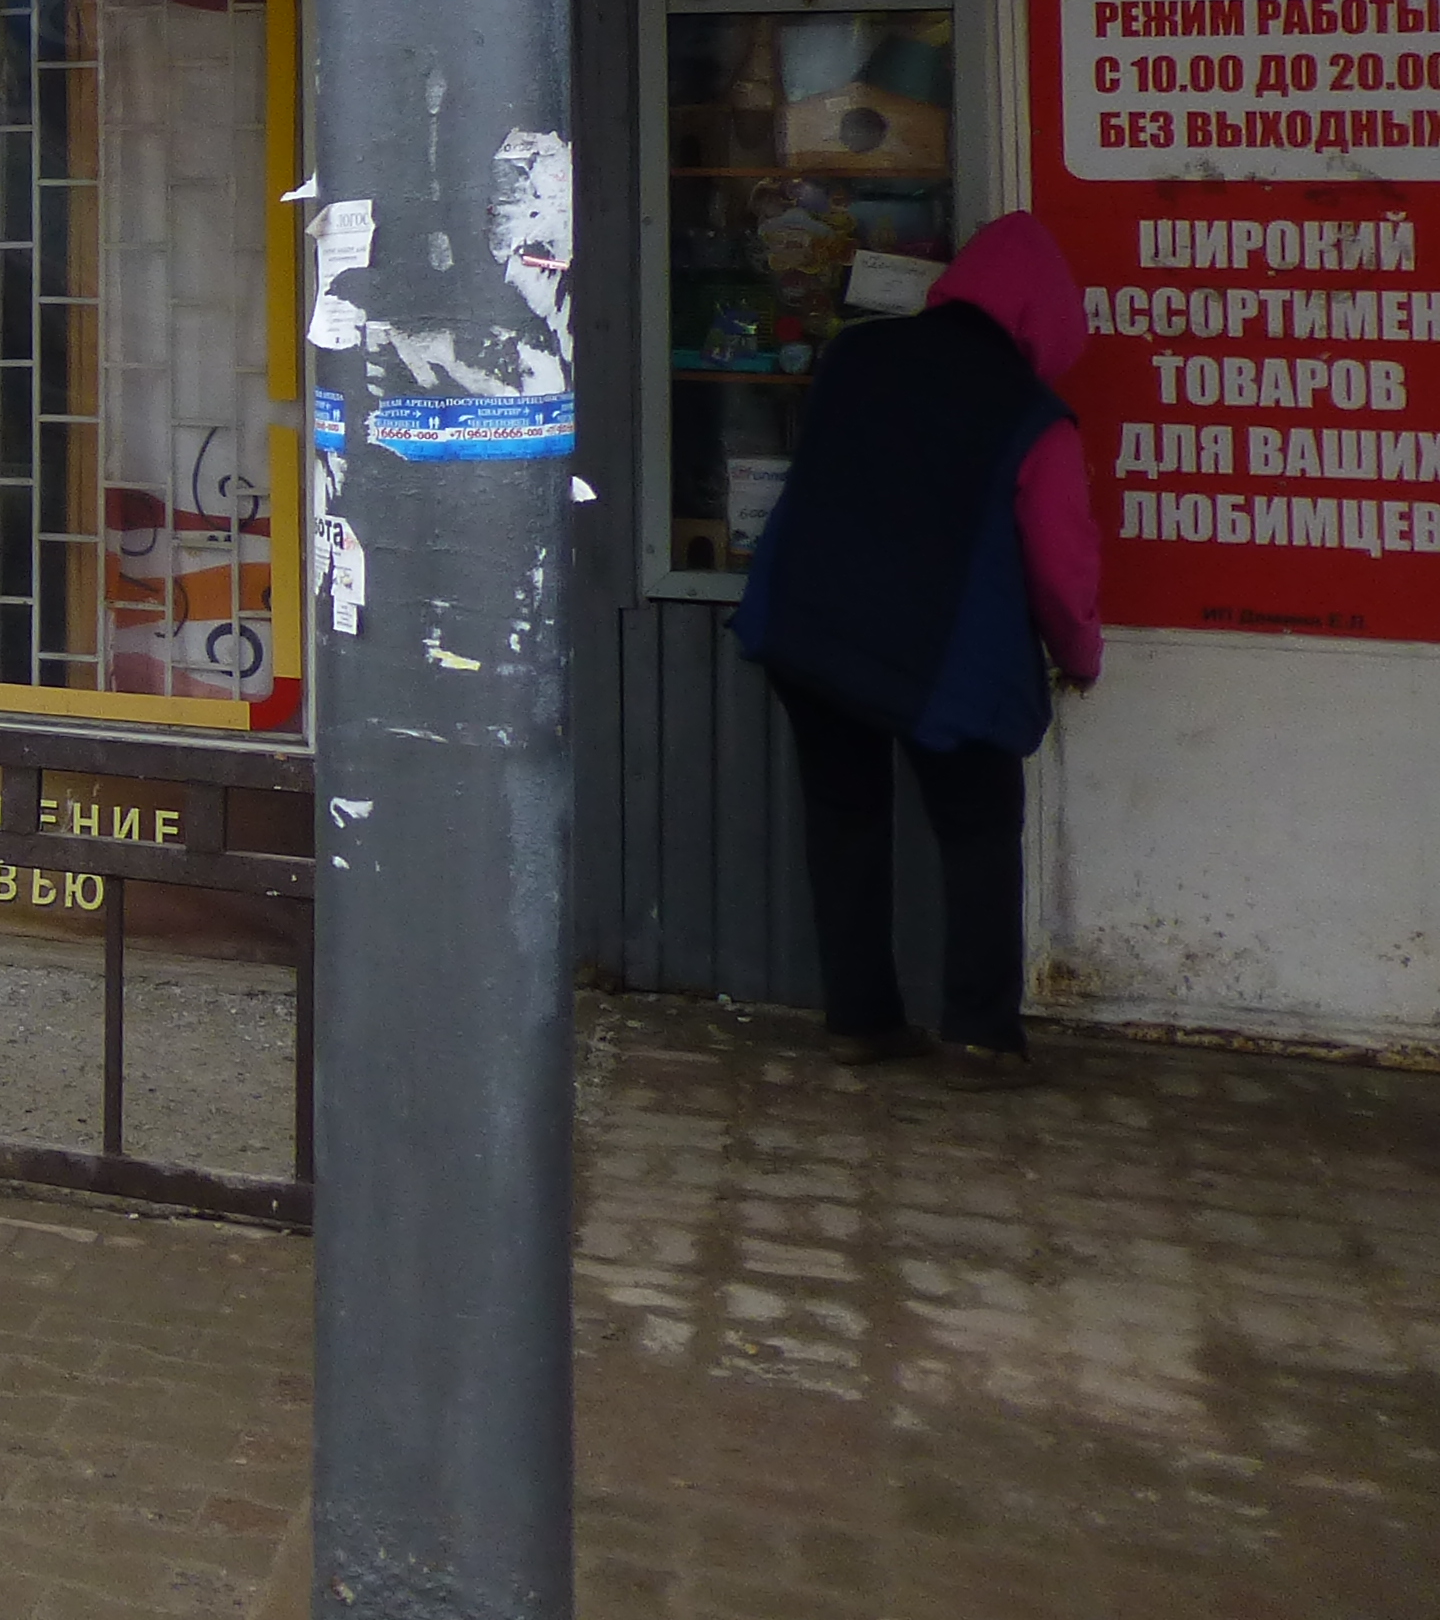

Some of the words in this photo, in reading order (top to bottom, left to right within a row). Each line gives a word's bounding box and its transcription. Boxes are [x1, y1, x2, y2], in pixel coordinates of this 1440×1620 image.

[1093, 56, 1121, 93] С
[1131, 55, 1244, 93] 10.00
[1254, 53, 1318, 98] ДО
[1328, 51, 1440, 93] 20.00
[1099, 111, 1175, 149] БЕЗ
[1138, 211, 1417, 273] ШИРОКИЙ
[1083, 286, 1440, 341] АССОРТИМЕН
[1151, 354, 1408, 413] ТОВАРОВ
[1115, 423, 1234, 481] ДЛЯ
[1119, 490, 1440, 559] ЛЮБИМЦЕВ
